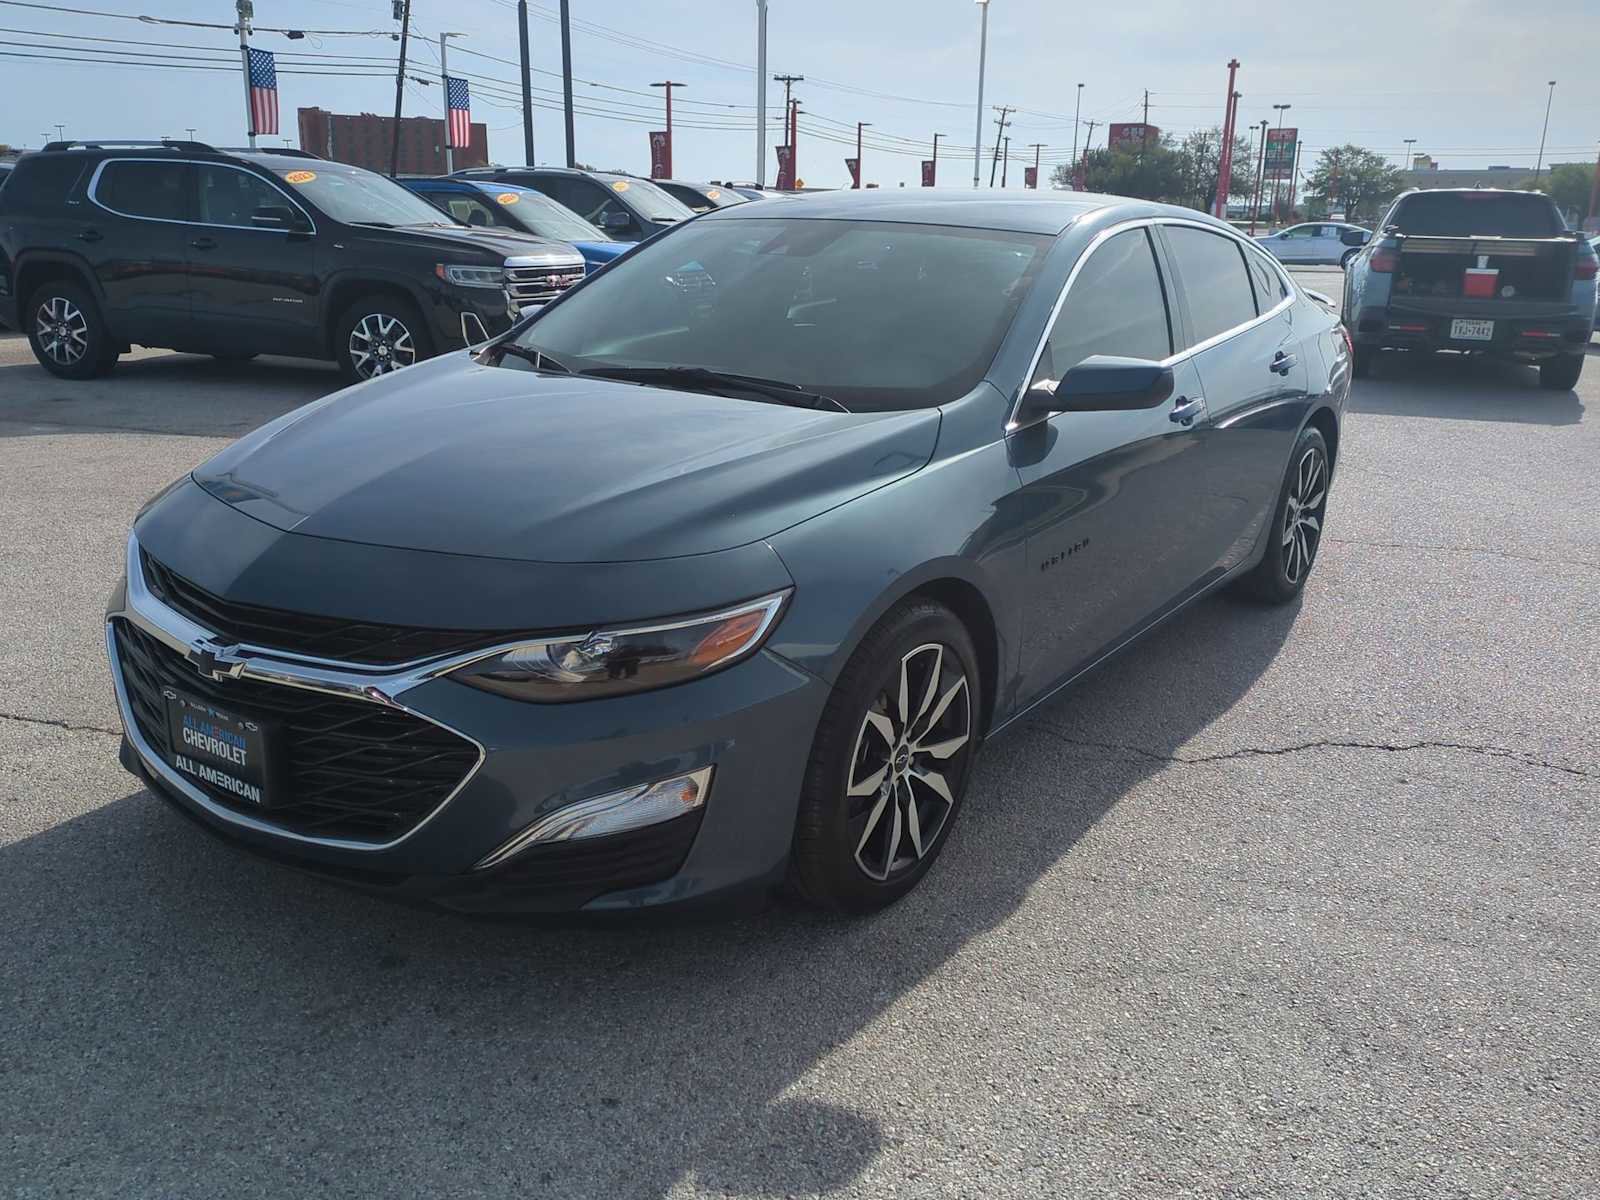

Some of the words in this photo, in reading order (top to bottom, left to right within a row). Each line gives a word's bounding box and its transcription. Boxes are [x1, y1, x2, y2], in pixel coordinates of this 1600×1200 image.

[183, 727, 247, 766] CHEVROLET
[176, 754, 197, 775] ALL
[199, 764, 261, 803] AMERICAN
